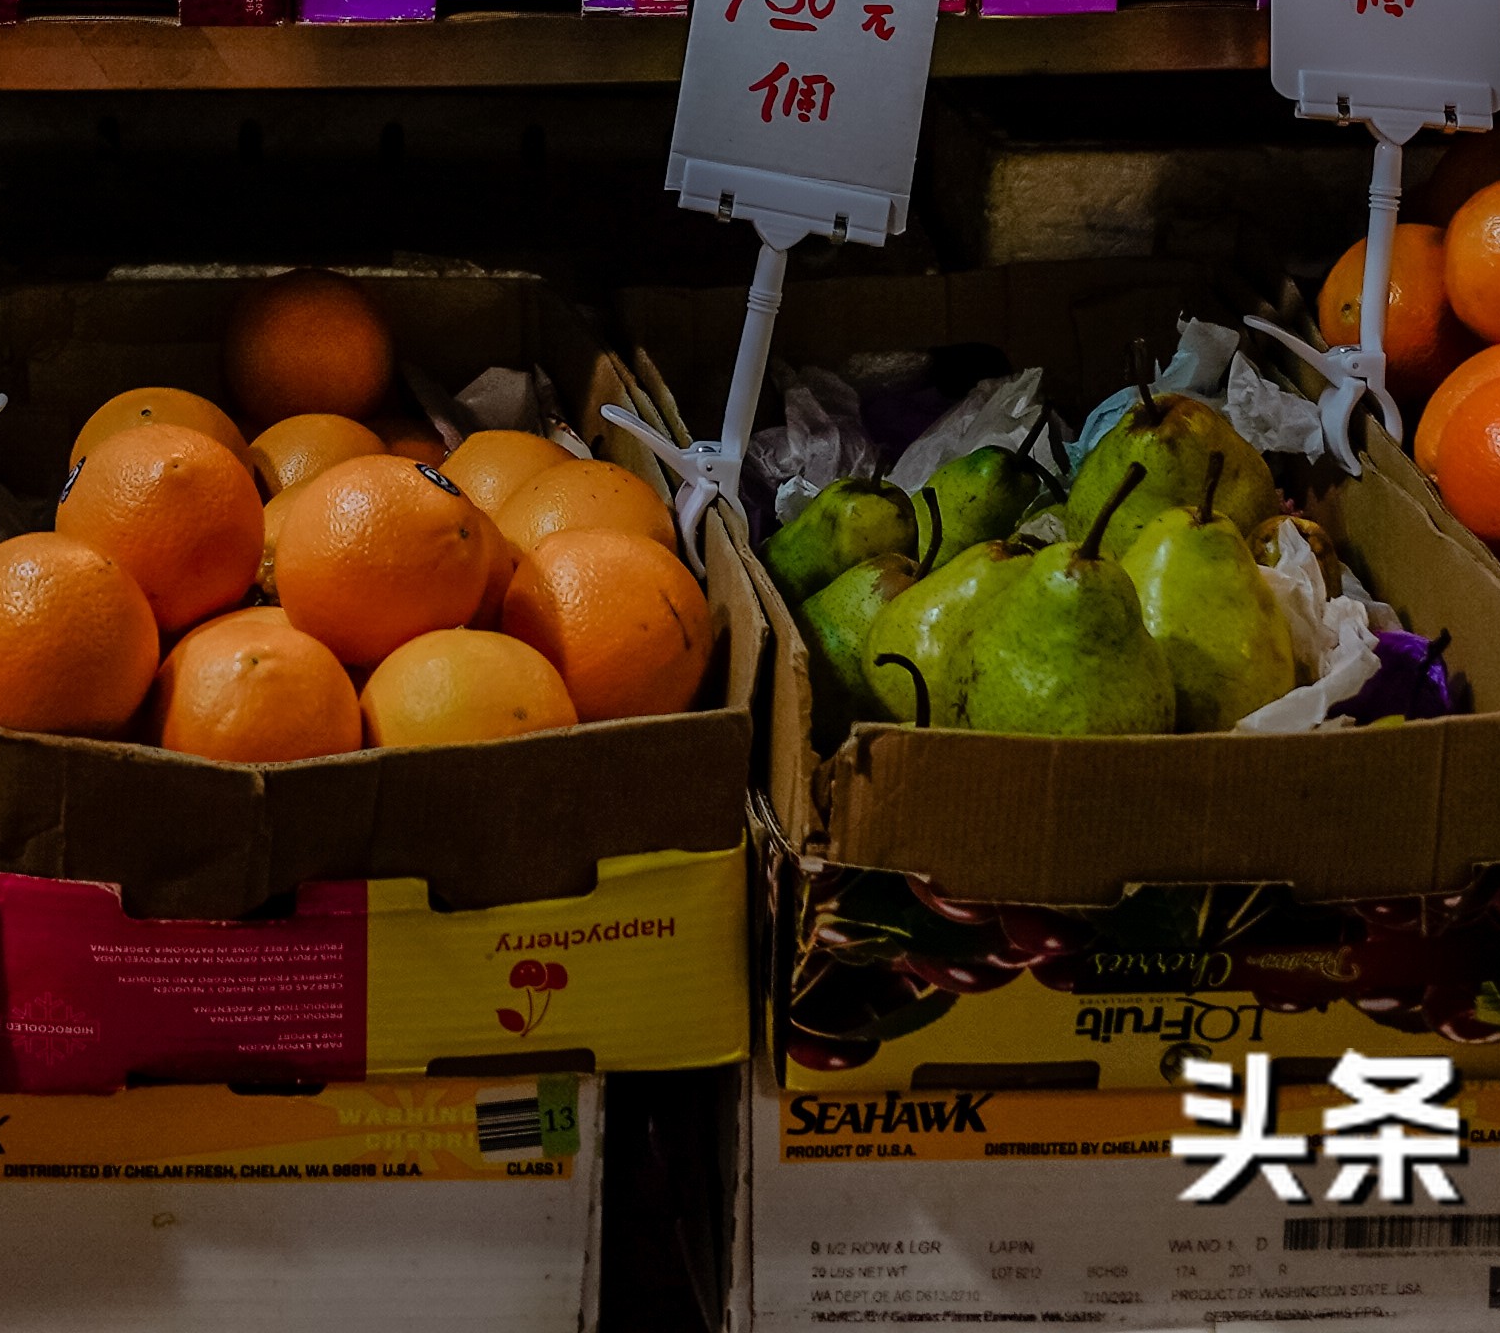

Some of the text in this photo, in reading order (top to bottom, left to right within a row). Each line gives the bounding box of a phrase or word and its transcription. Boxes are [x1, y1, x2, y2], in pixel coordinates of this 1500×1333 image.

[749, 62, 834, 123] 個
[494, 915, 677, 954] Happycherry
[541, 1104, 576, 1134] 13
